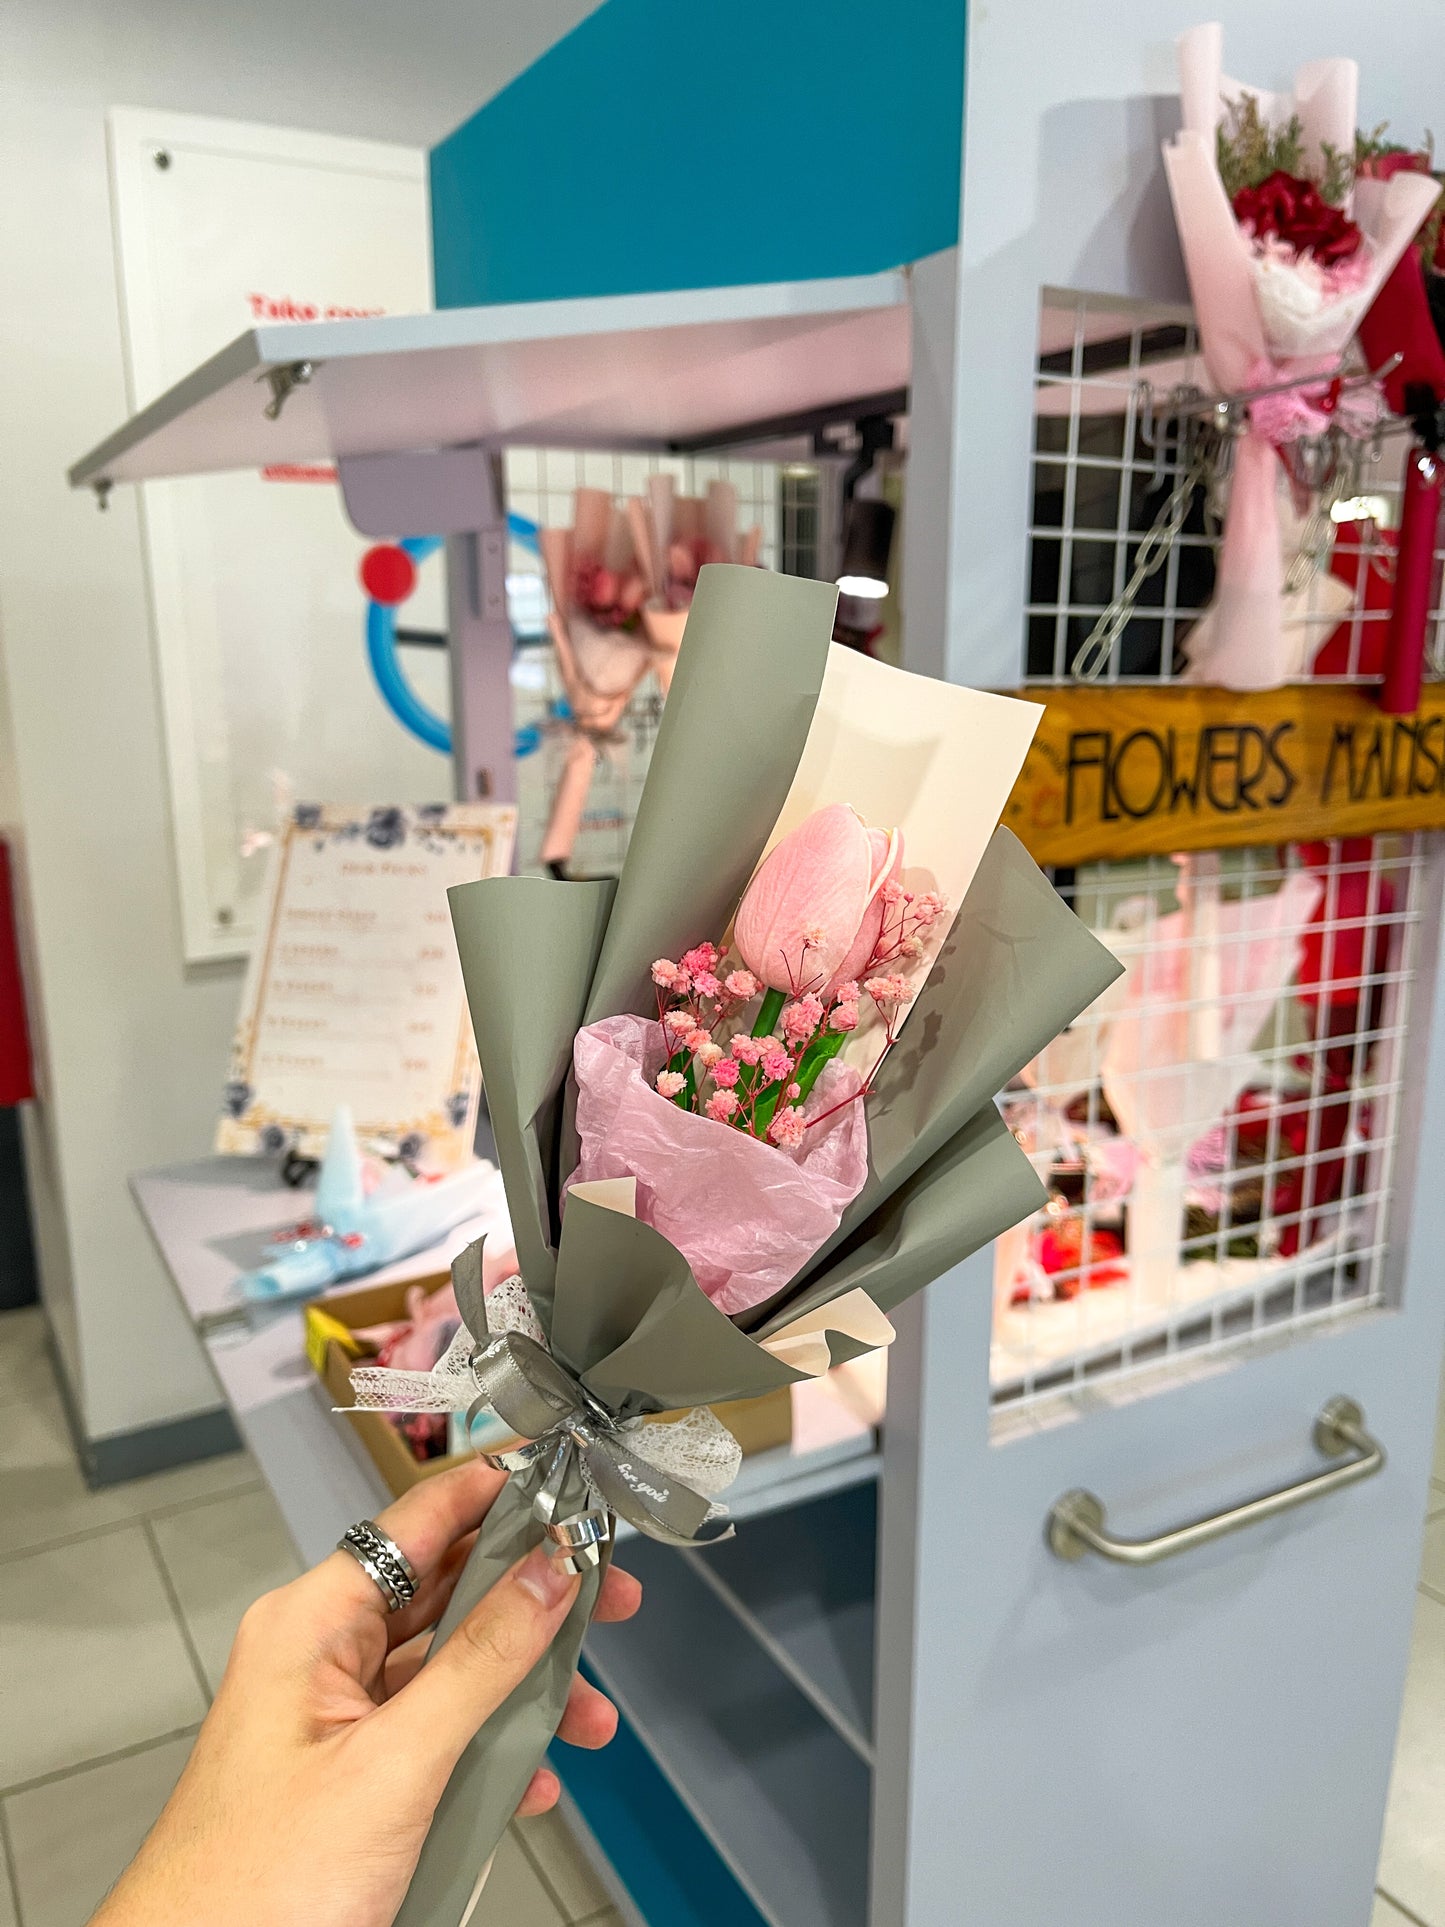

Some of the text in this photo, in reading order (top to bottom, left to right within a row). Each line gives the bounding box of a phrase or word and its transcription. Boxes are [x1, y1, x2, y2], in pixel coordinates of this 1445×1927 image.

[1063, 720, 1297, 825] FLOWERS
[1318, 715, 1445, 806] MANS
[629, 1483, 668, 1503] you
